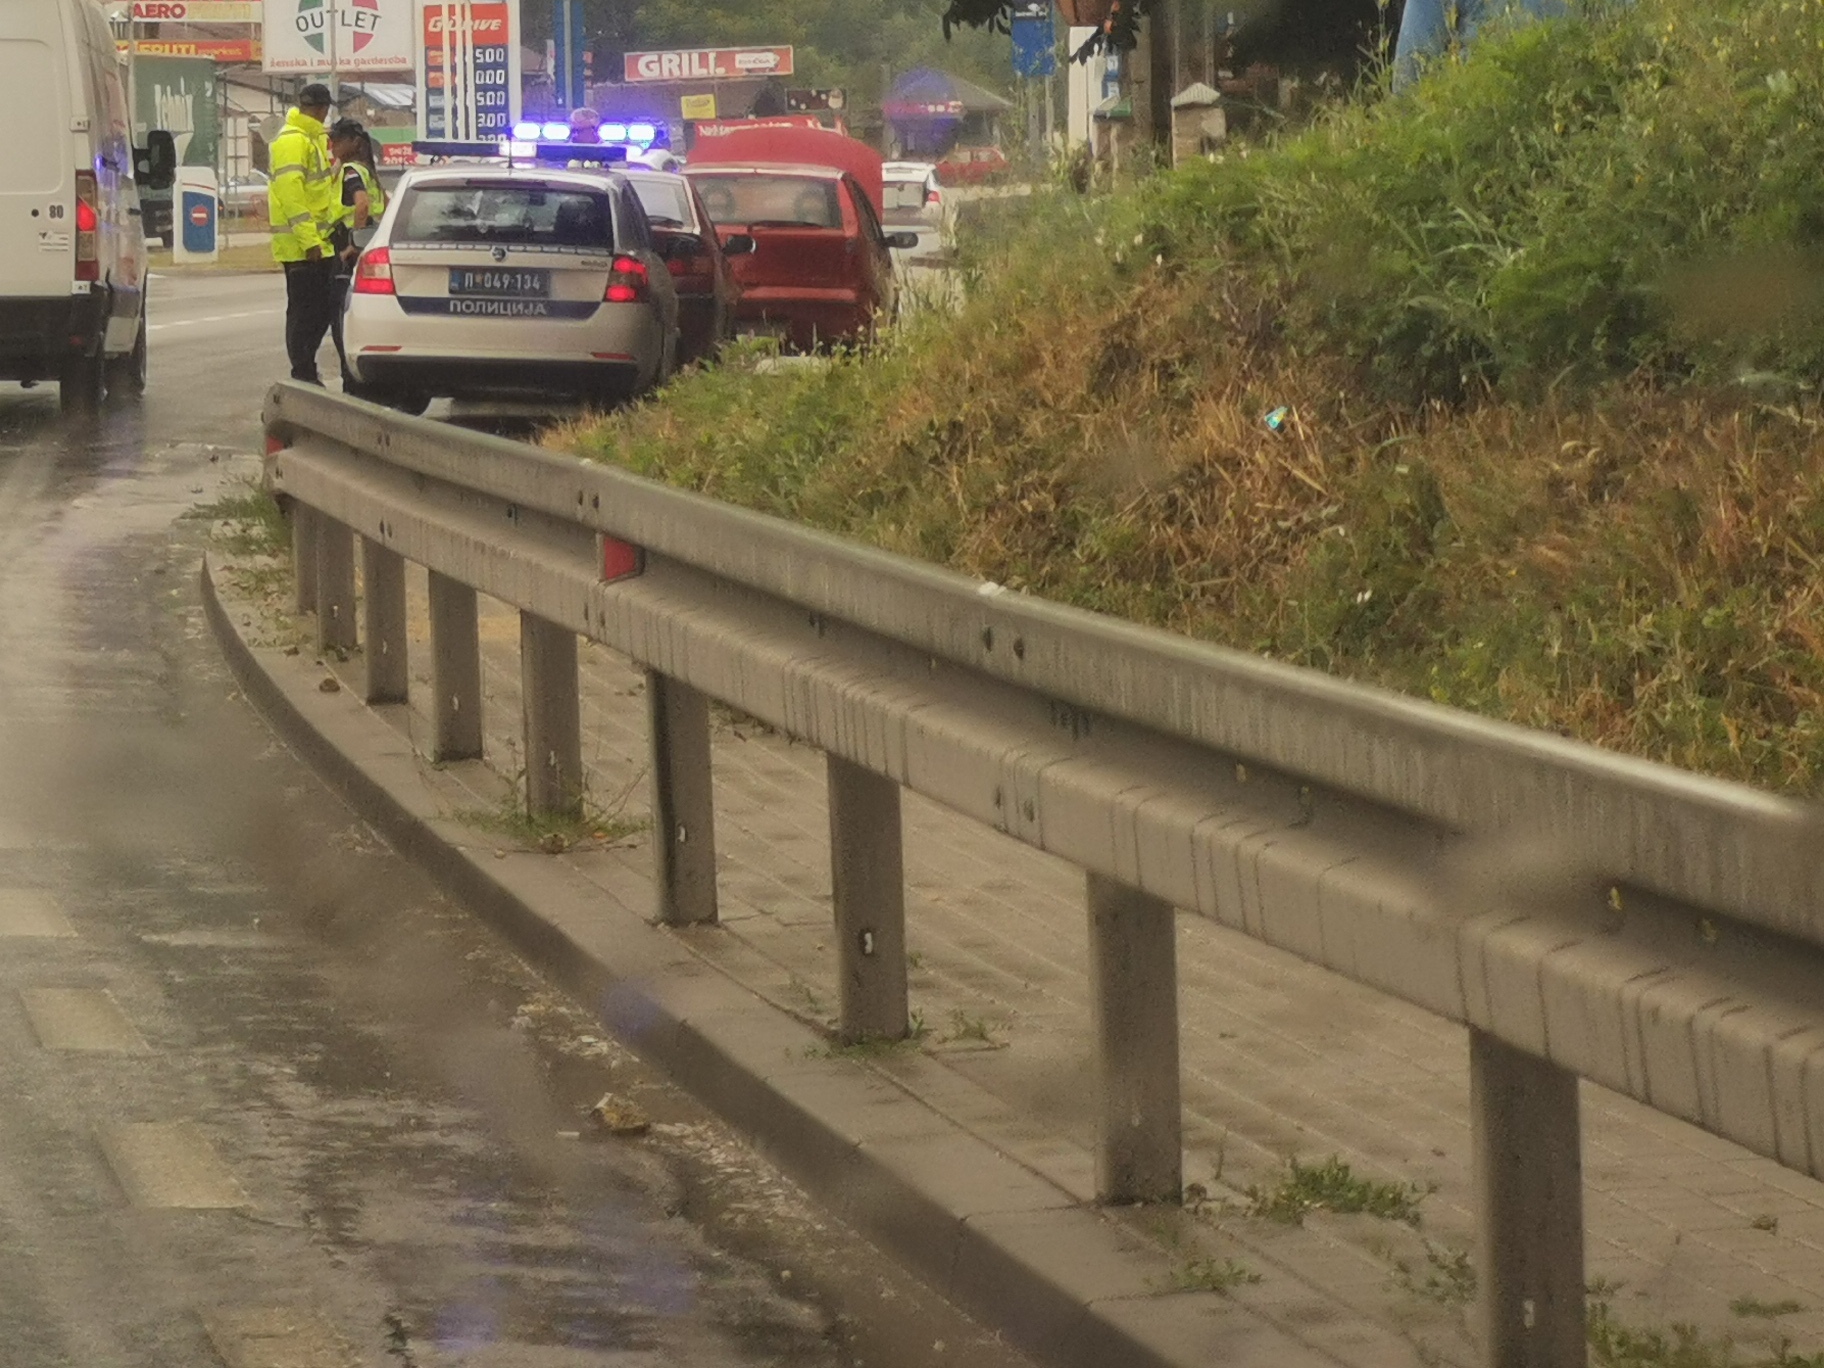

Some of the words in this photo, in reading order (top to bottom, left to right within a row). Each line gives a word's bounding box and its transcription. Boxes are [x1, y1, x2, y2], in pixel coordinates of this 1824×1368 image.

[295, 9, 382, 32] OULET
[317, 56, 352, 67] muka
[353, 56, 407, 69] garderoba
[49, 205, 64, 219] 80
[449, 299, 547, 316] ПОЛИЦИЈА
